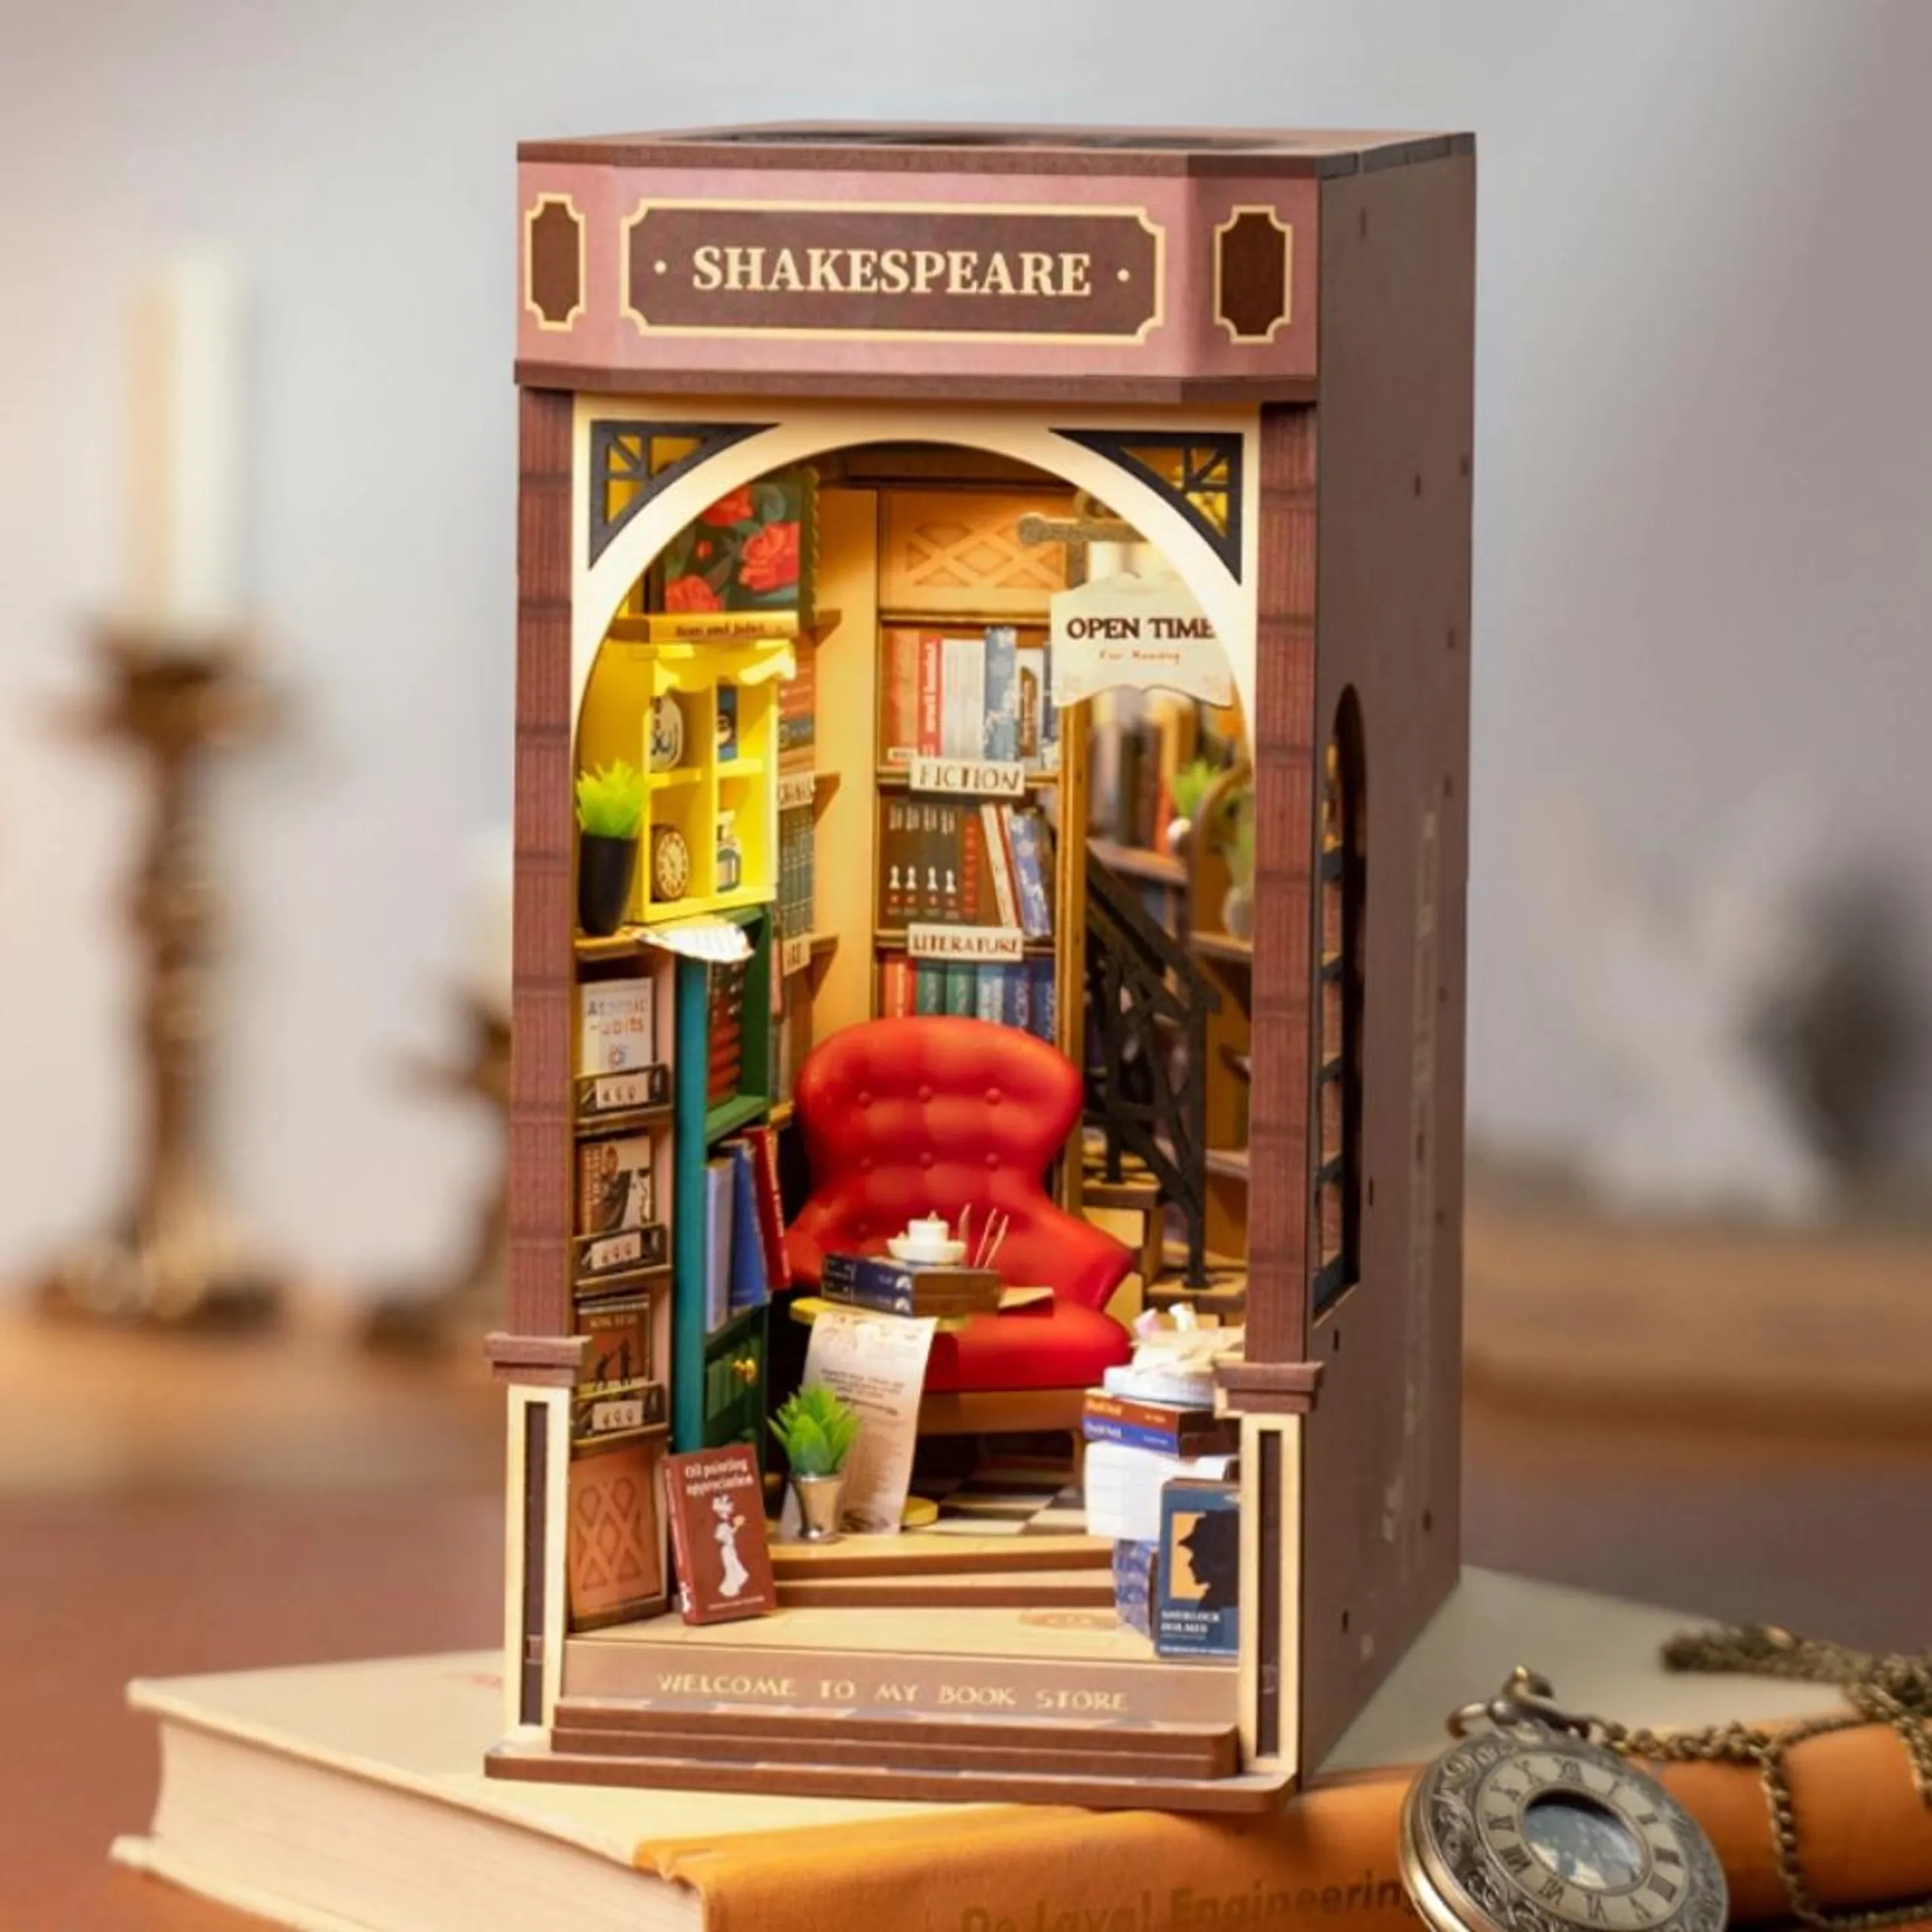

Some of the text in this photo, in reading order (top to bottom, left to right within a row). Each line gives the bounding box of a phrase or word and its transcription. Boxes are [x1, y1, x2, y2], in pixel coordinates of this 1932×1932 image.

[692, 245, 1092, 297] SHAKESPEARE
[1066, 617, 1140, 639] OPEN
[920, 764, 1020, 791] FICTION
[659, 1672, 1127, 1711] WELCOME TO MY BOOK STORE
